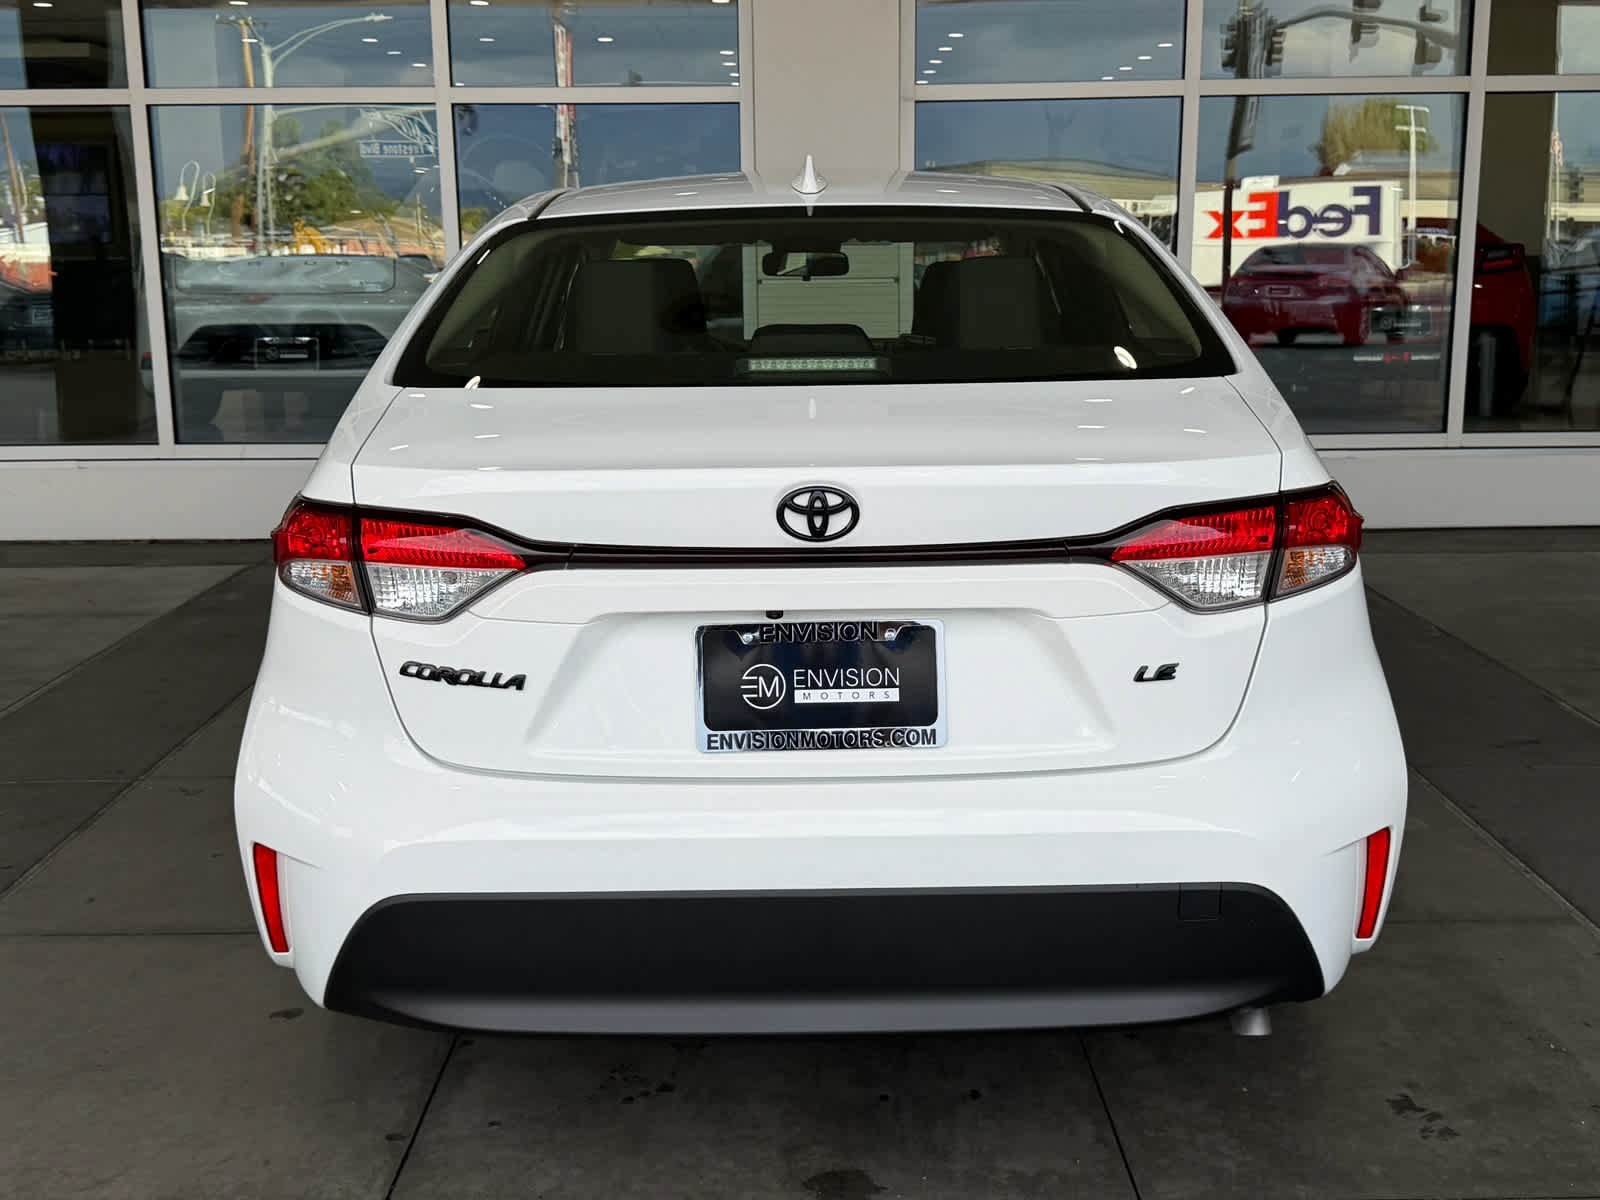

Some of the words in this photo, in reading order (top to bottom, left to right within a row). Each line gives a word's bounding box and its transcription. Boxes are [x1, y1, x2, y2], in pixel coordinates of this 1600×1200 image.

[759, 623, 878, 642] ENVISION
[399, 660, 527, 691] COROLLA
[794, 667, 900, 688] ENVISION
[1133, 662, 1180, 682] LE
[801, 691, 891, 701] MOTORS
[706, 729, 938, 750] ENVISIONMOTORS.COM
